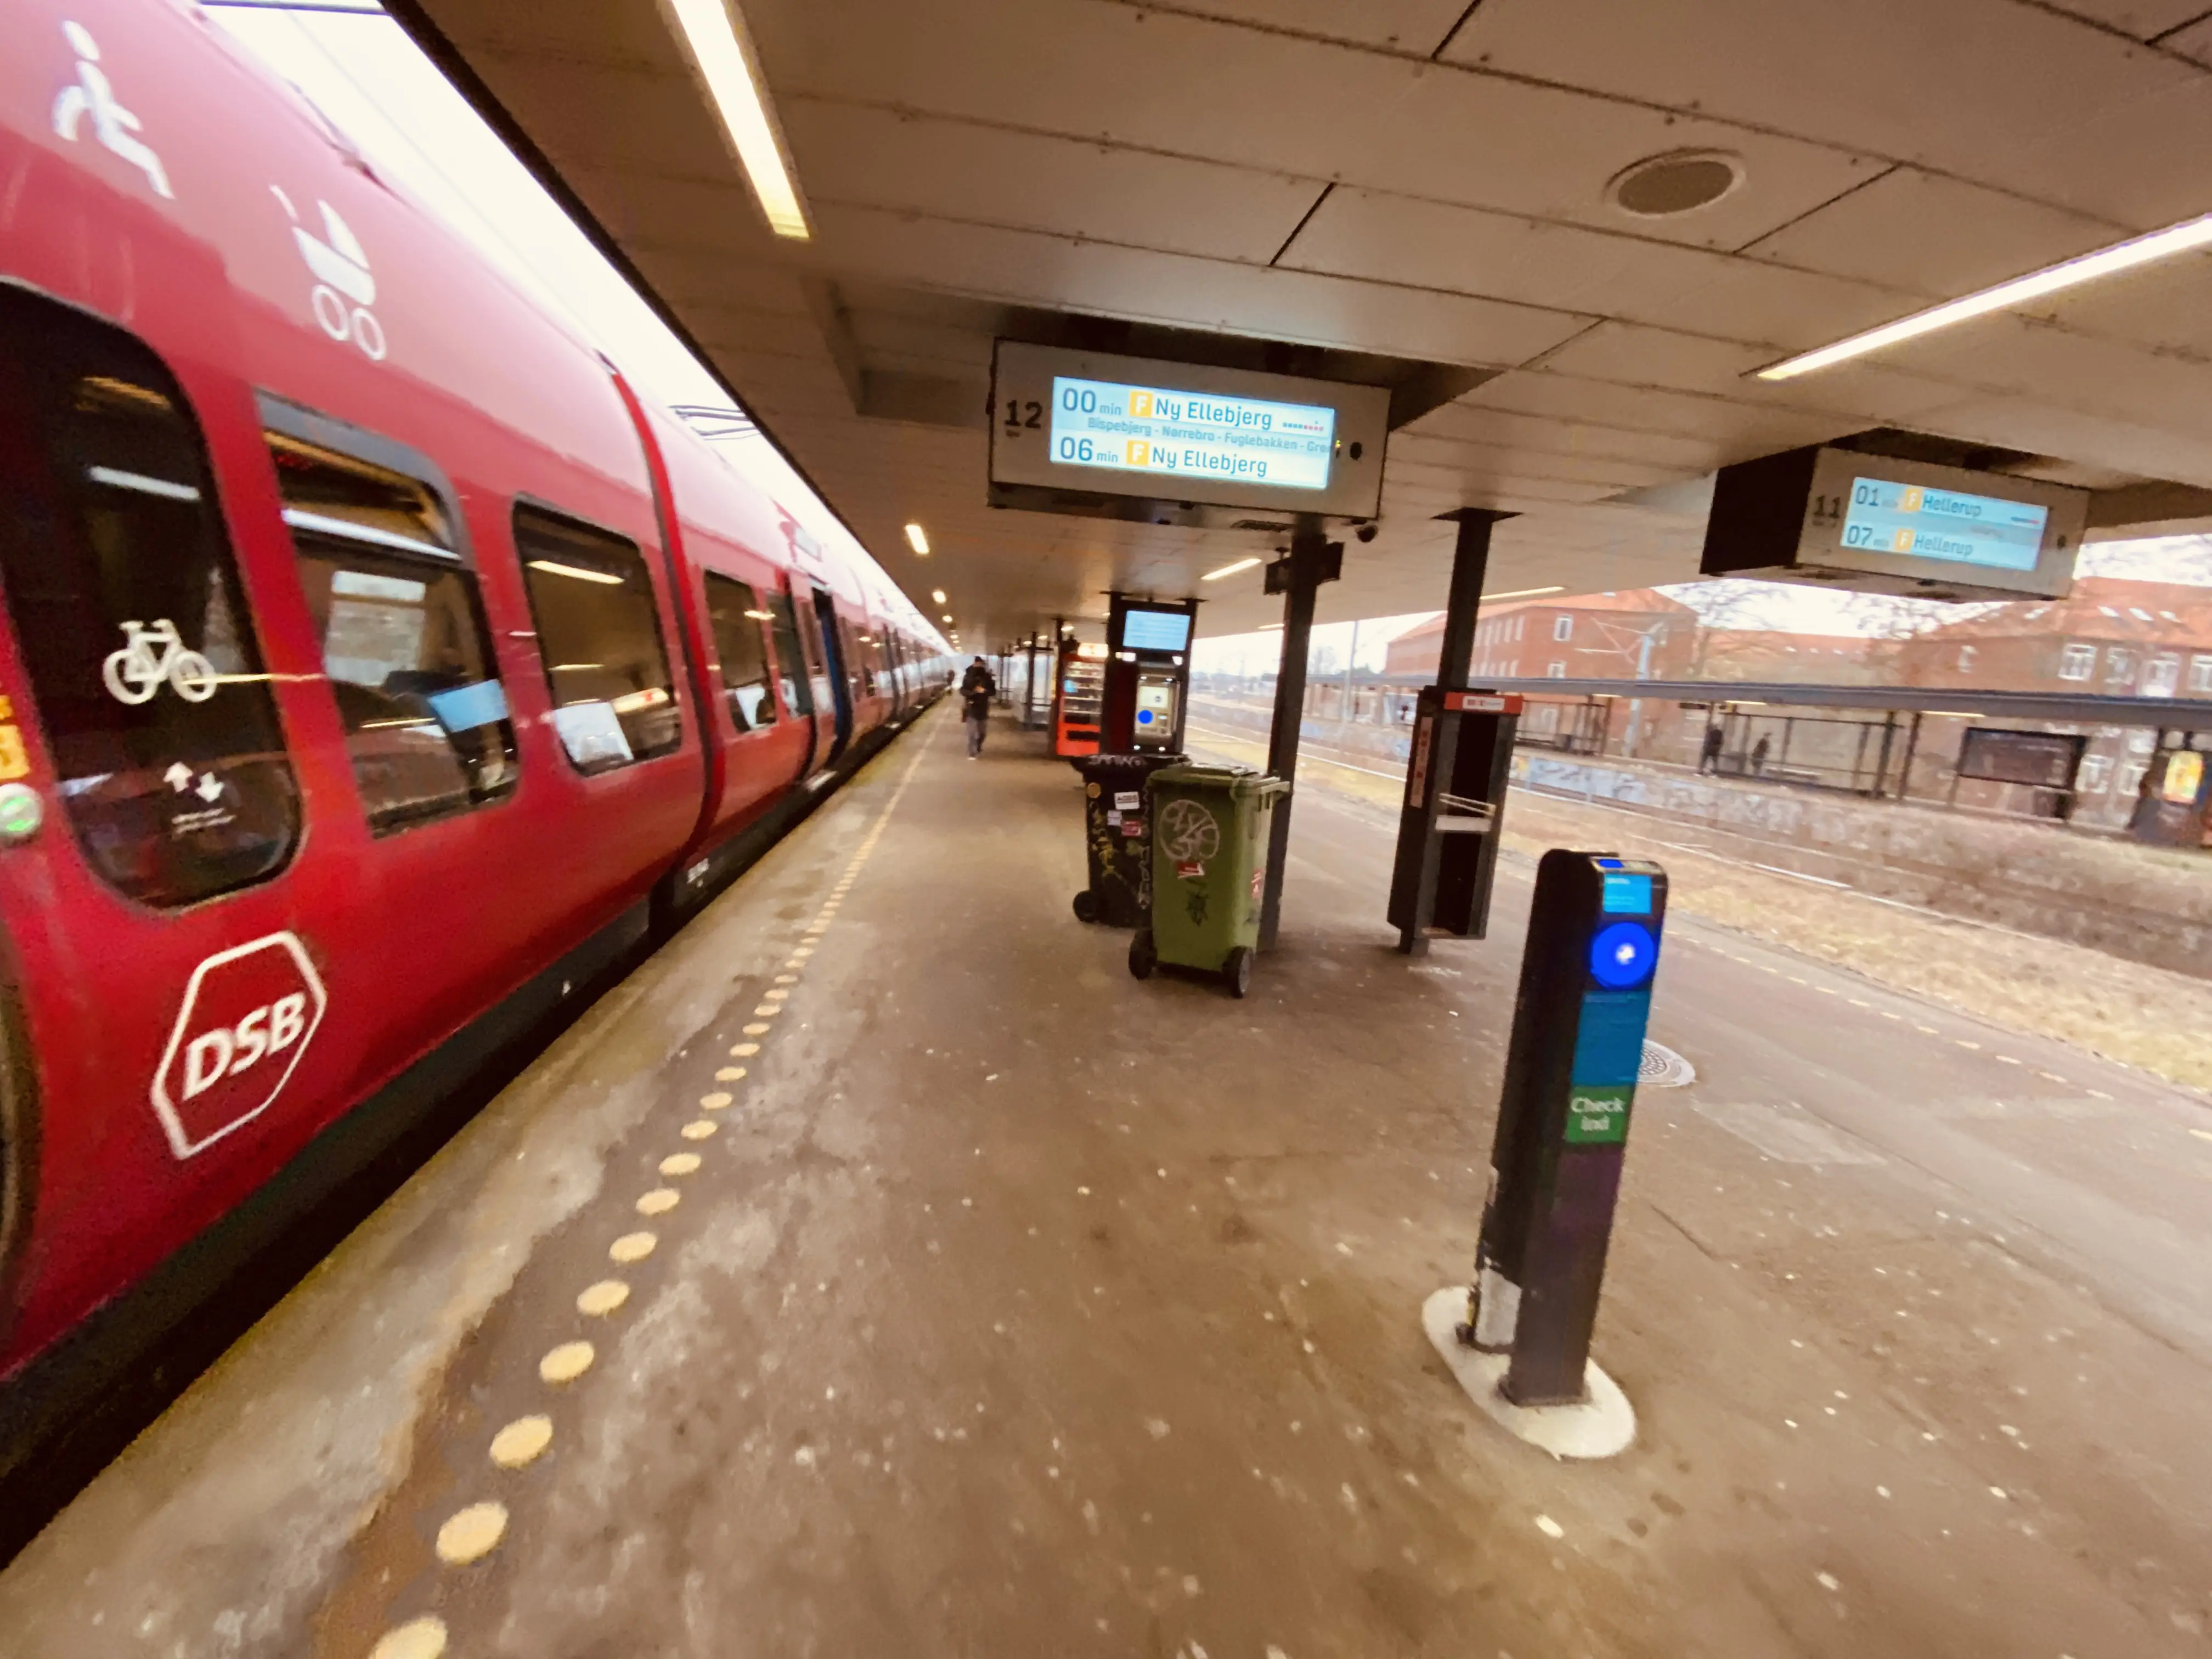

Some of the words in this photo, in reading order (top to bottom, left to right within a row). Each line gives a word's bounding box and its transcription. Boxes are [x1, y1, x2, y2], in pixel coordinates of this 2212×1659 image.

[1005, 399, 1042, 429] 12
[1063, 388, 1096, 413] 00
[1099, 403, 1122, 415] min
[1136, 394, 1148, 415] F
[1156, 397, 1181, 421] Ny
[1187, 402, 1272, 431] Ellebjerg
[1088, 417, 1152, 437] Bispebjerg
[1224, 432, 1298, 450] Fuglebakken
[1060, 436, 1093, 461] 06
[1097, 451, 1119, 463] min
[1132, 443, 1146, 462] F
[1153, 447, 1177, 469] Ny
[1184, 450, 1268, 478] Ellebjerg
[1813, 495, 1841, 518] 11
[1855, 485, 1878, 506] 01
[1908, 492, 1918, 507] F
[1922, 494, 1982, 517] Hellerup
[1847, 525, 1873, 546] 07
[1899, 532, 1910, 547] F
[1914, 535, 1974, 557] Hellerup
[182, 991, 307, 1102] DSB
